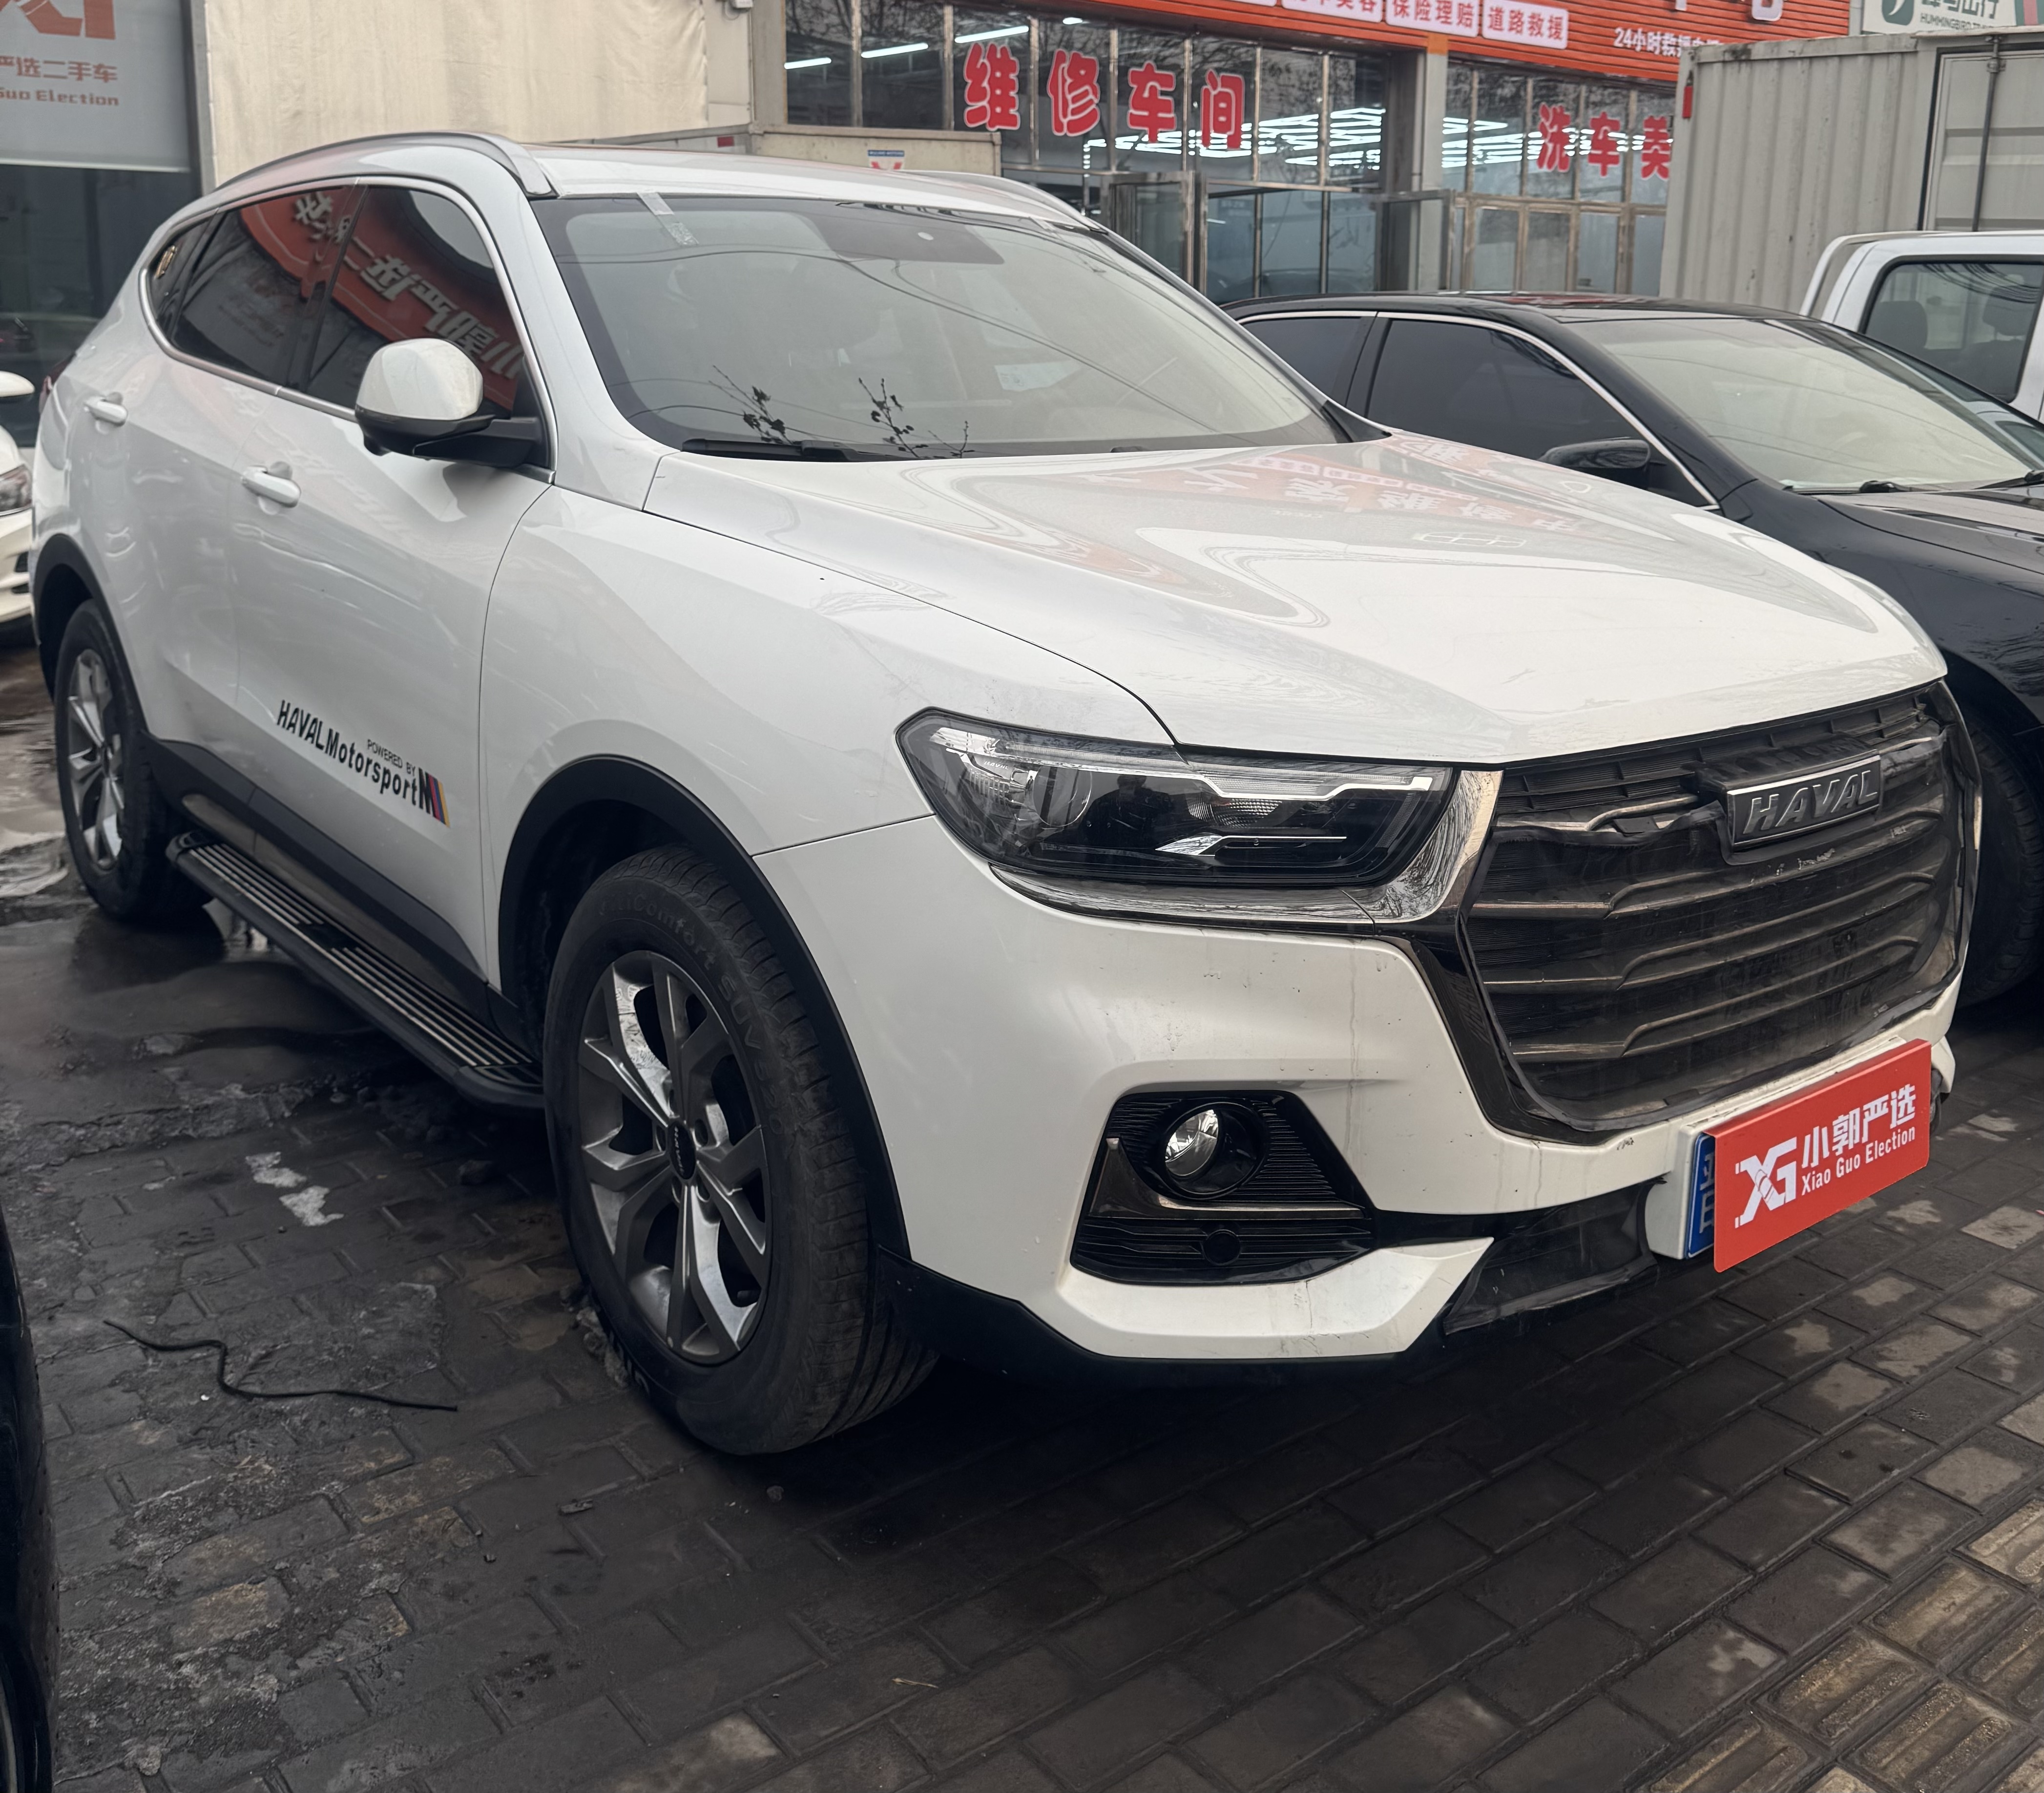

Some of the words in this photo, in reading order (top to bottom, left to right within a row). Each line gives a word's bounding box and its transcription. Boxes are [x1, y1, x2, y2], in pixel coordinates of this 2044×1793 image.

[1393, 0, 1475, 28] 保险理赔
[1489, 6, 1564, 40] 道路救援
[36, 90, 119, 106] Election
[963, 42, 1245, 150] 维修车间
[367, 739, 403, 768] POWERED
[406, 762, 416, 777] BY
[1743, 770, 1877, 834] HAVAL
[1801, 1084, 1916, 1168] 小郭严选
[1801, 1168, 1831, 1196] Xiao
[1835, 1154, 1860, 1178] Guo
[1865, 1126, 1916, 1164] Election
